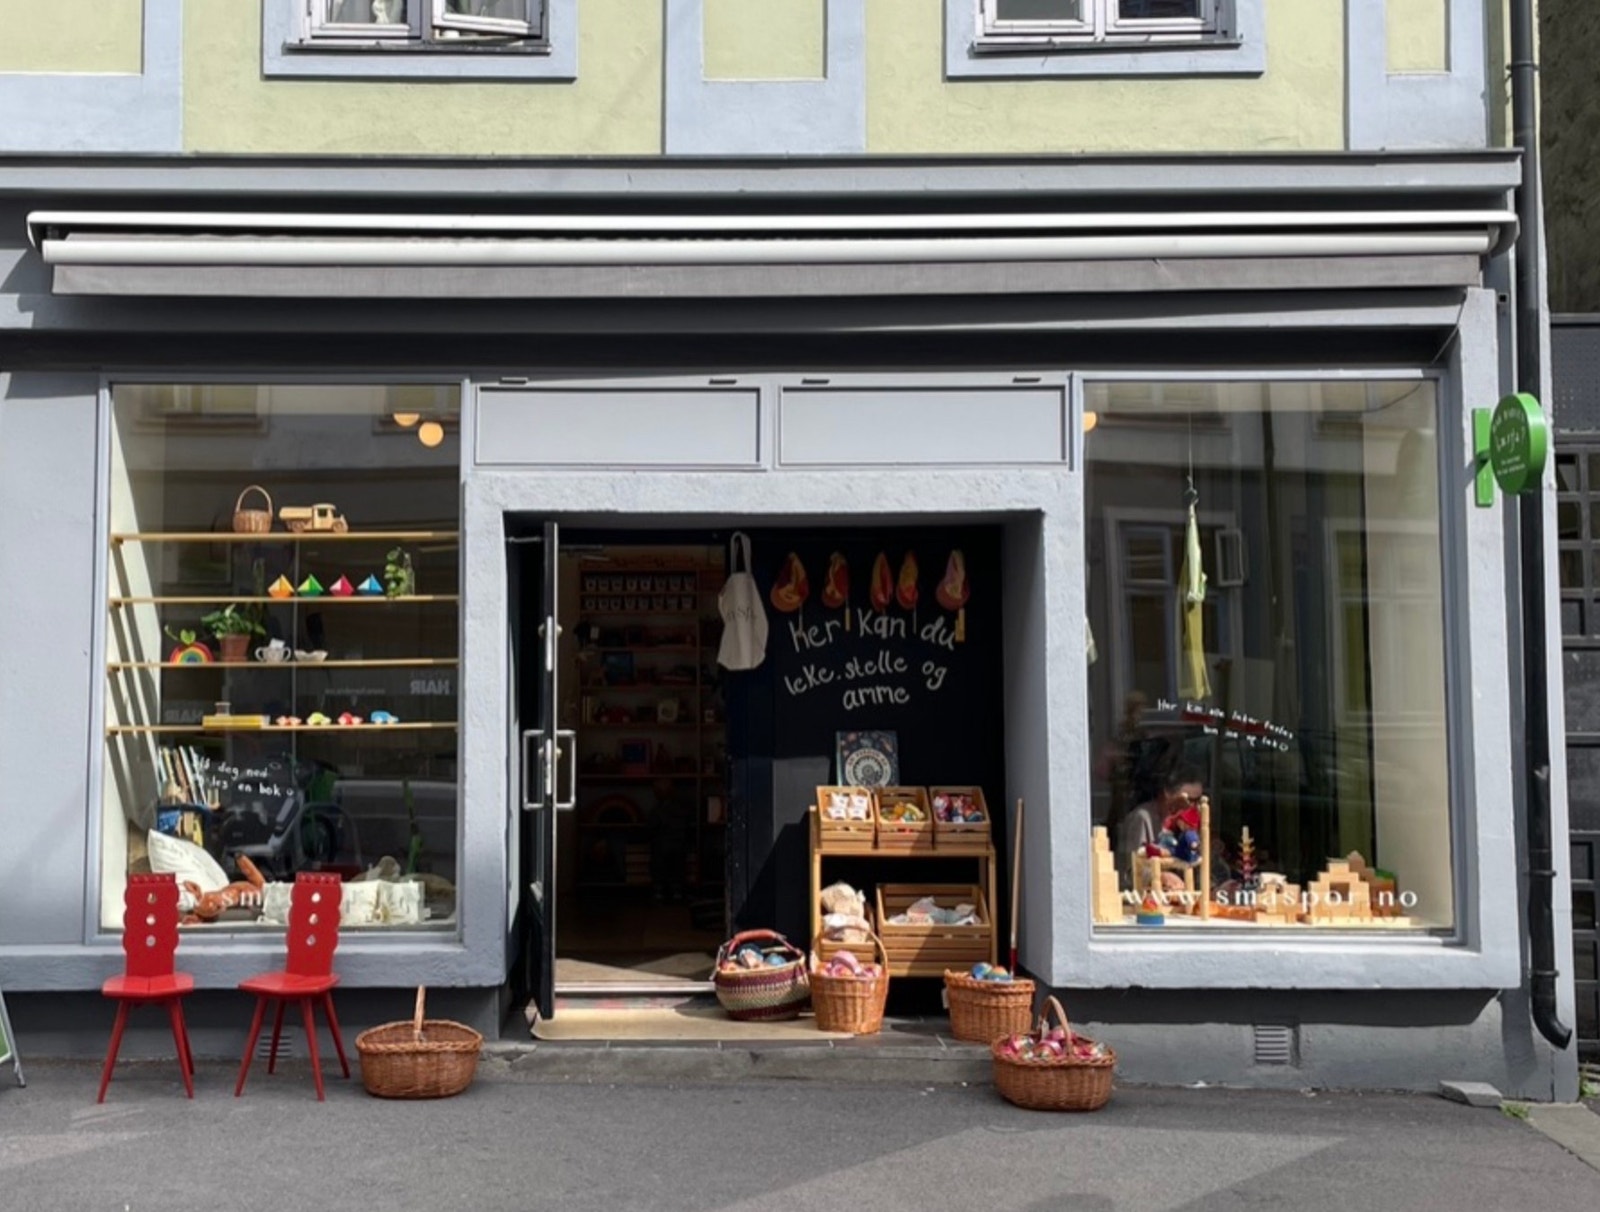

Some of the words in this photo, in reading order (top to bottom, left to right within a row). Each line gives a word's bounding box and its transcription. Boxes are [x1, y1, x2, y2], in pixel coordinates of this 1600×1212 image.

[920, 615, 955, 651] du
[844, 649, 908, 680] stelle
[921, 660, 948, 691] og
[842, 684, 910, 711] amme
[218, 761, 240, 781] deg
[246, 767, 268, 779] ned
[238, 783, 252, 793] en
[259, 782, 281, 797] bok
